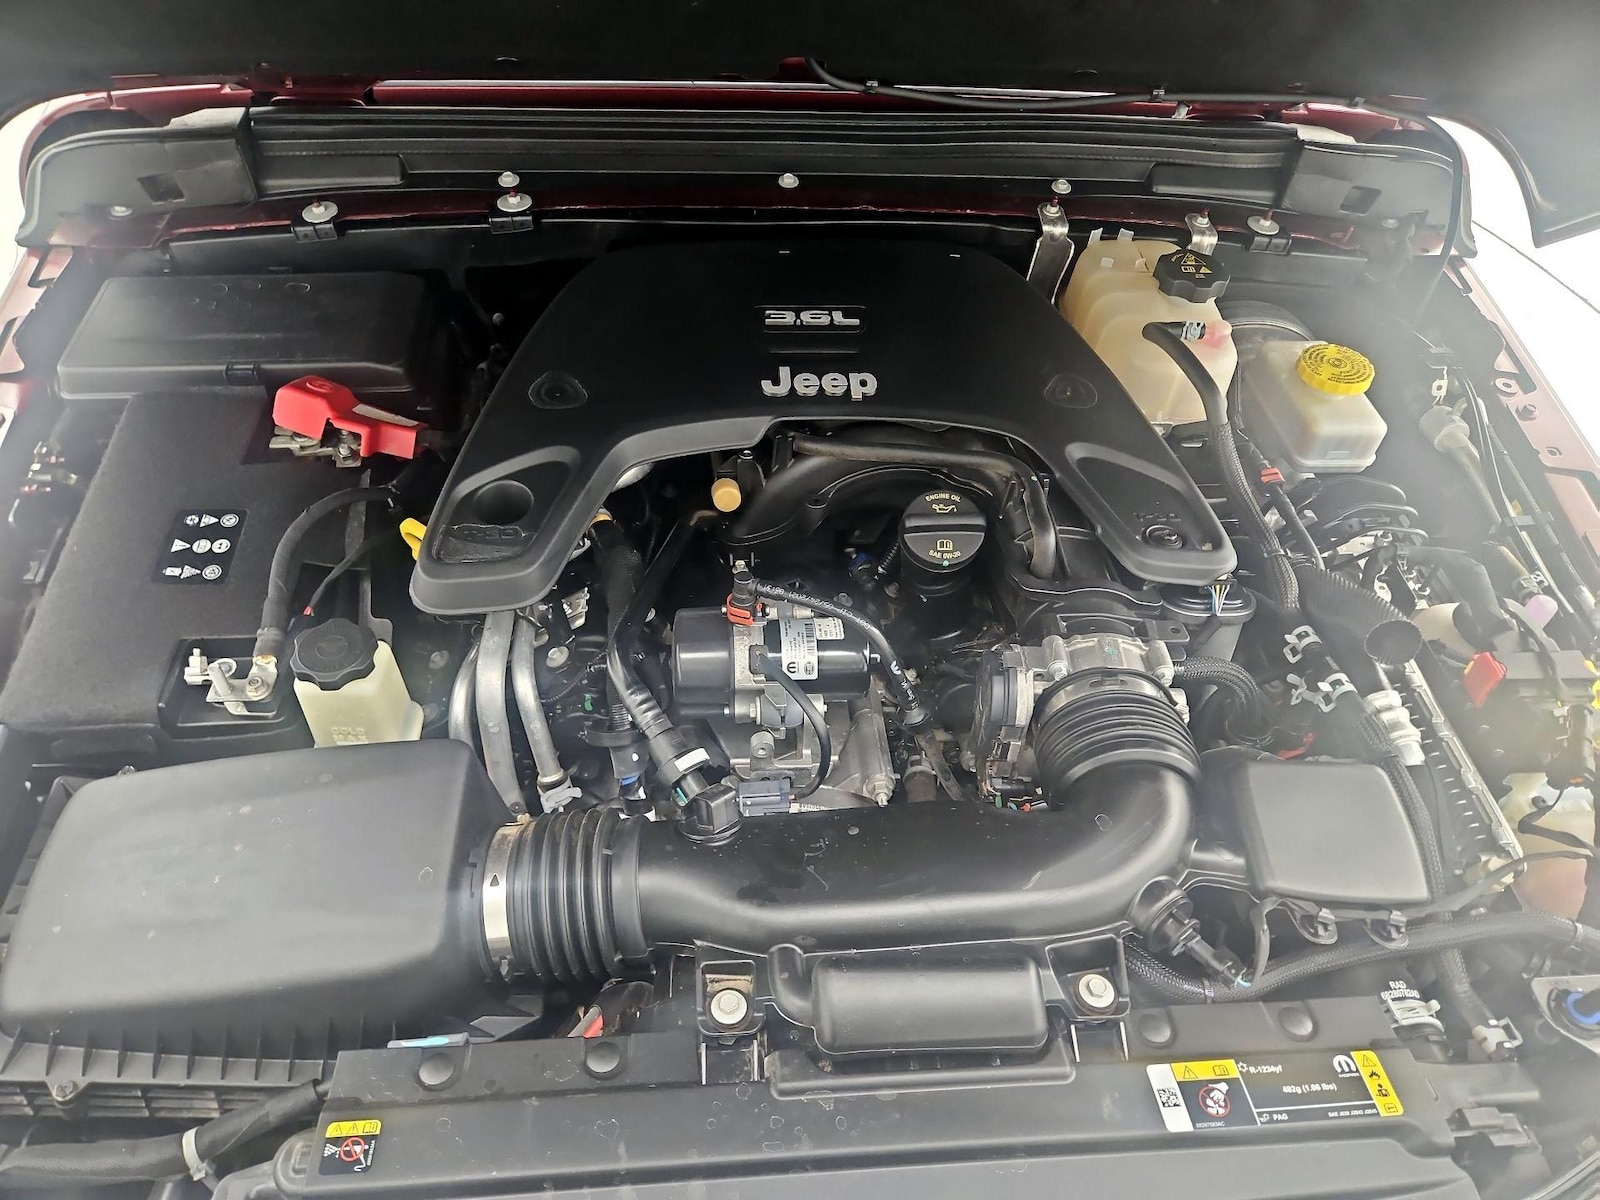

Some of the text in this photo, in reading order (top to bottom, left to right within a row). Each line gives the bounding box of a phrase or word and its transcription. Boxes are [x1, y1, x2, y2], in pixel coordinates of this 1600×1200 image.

[764, 310, 860, 326] 3.6L
[760, 366, 878, 401] Jeep
[925, 493, 961, 503] ENGINE OIL
[928, 549, 942, 559] SAE
[331, 727, 365, 735] COLD
[1388, 980, 1407, 990] RAD
[1282, 1085, 1302, 1094] 482g
[1321, 1082, 1337, 1092] lbs)
[1272, 1113, 1289, 1121] PAG
